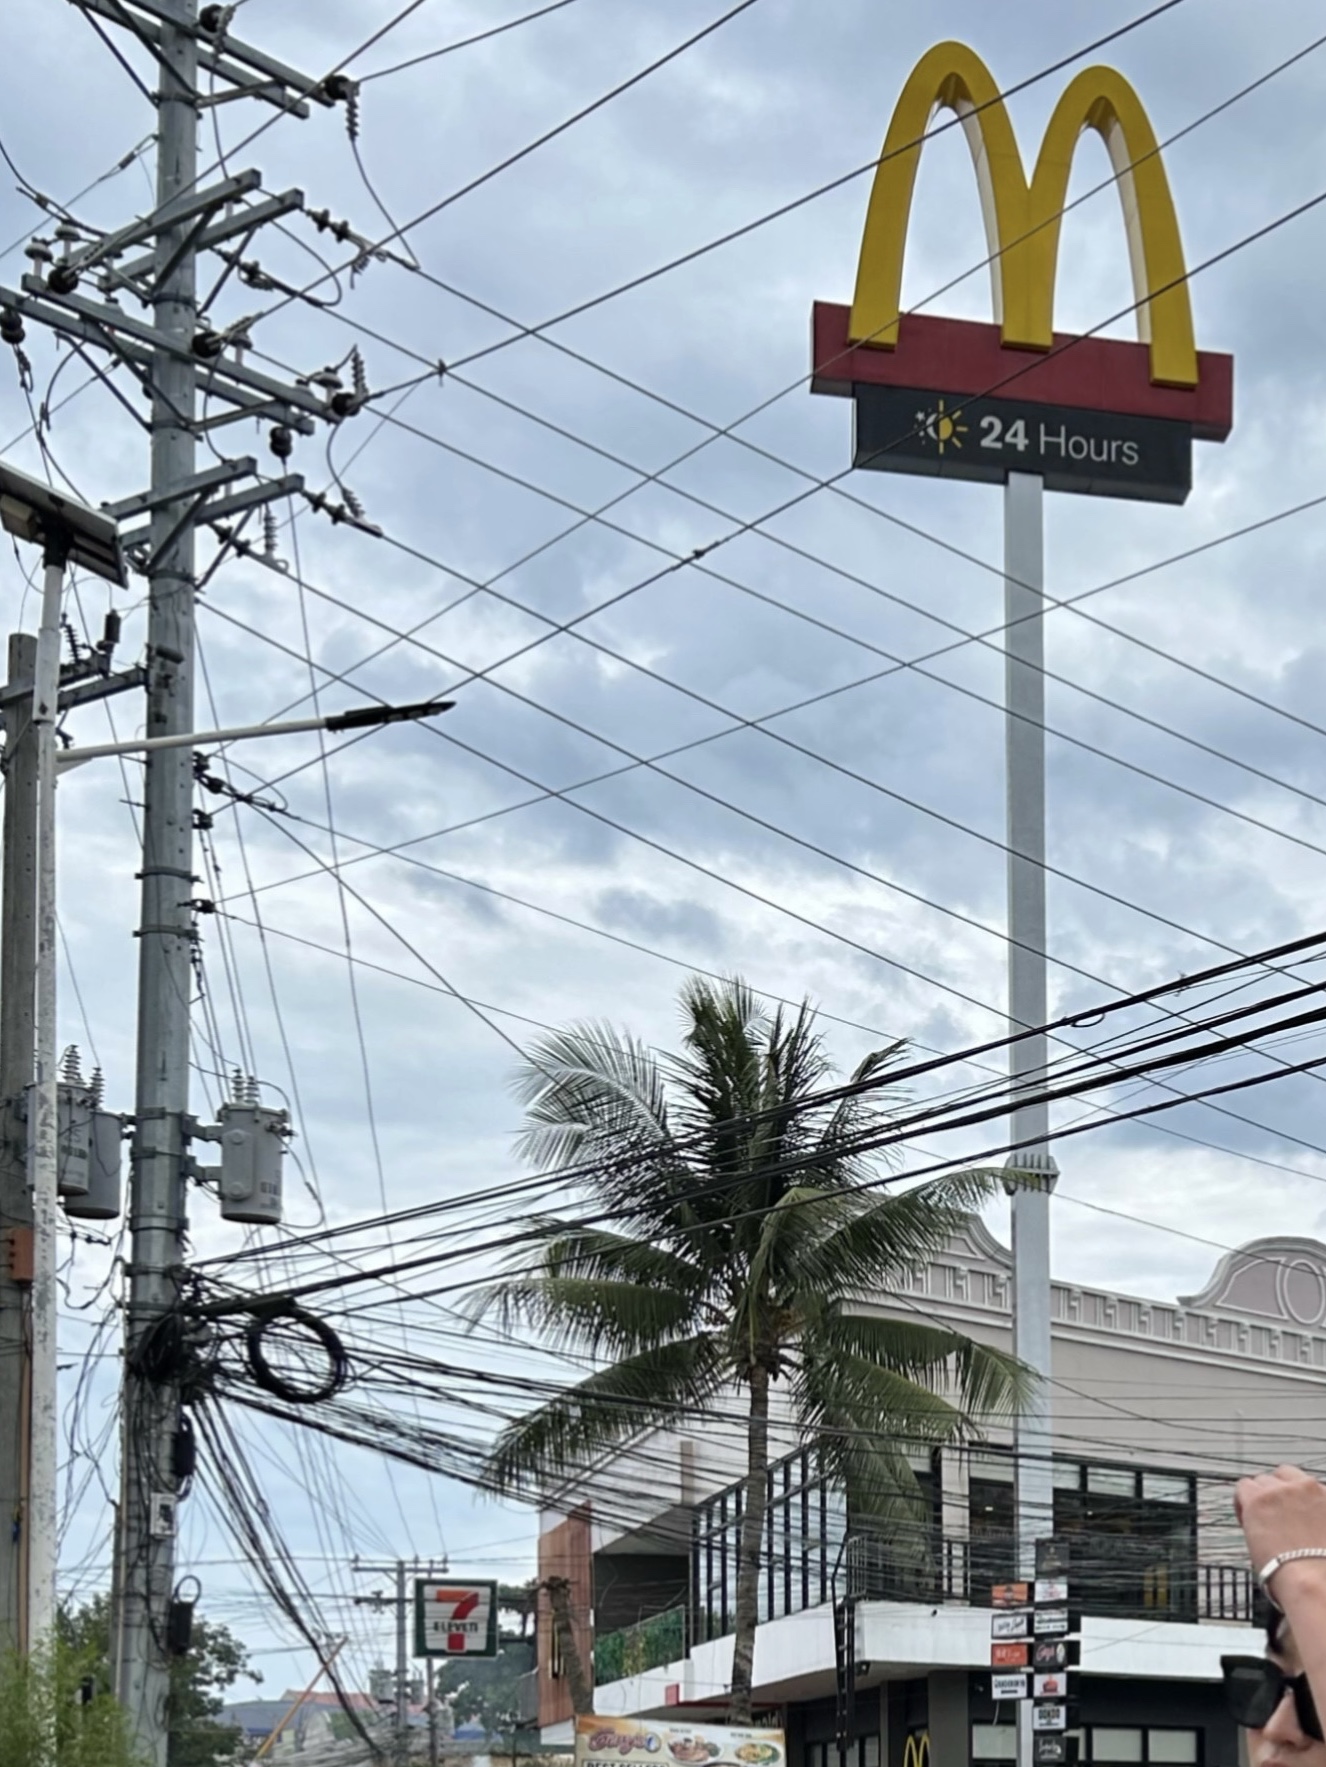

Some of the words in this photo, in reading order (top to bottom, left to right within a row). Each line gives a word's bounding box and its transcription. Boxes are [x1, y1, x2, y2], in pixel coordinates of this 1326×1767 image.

[979, 415, 1029, 451] 24
[1040, 422, 1139, 465] Hours
[435, 1589, 479, 1650] 7
